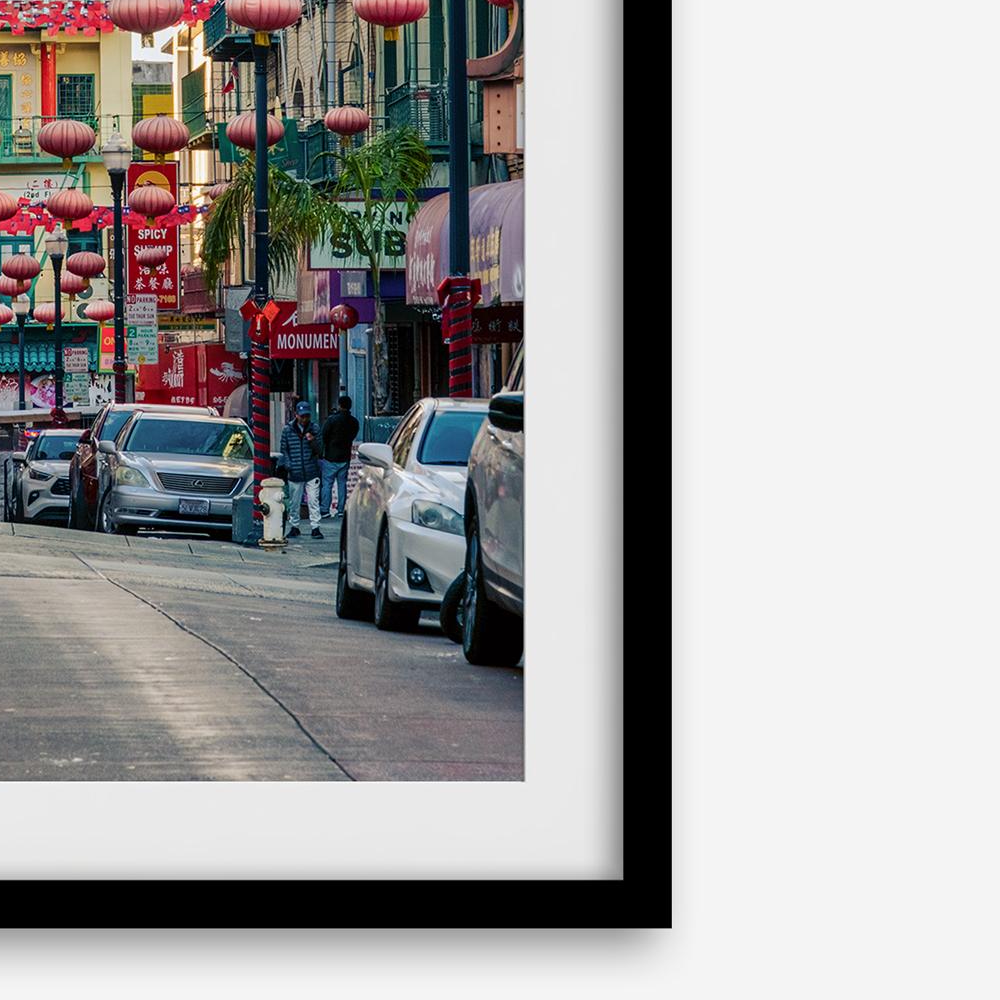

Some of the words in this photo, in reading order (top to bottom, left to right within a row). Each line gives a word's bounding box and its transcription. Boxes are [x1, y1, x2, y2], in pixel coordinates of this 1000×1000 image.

[138, 229, 167, 240] SPICY
[129, 328, 135, 338] 2
[277, 333, 341, 350] MONUMEN
